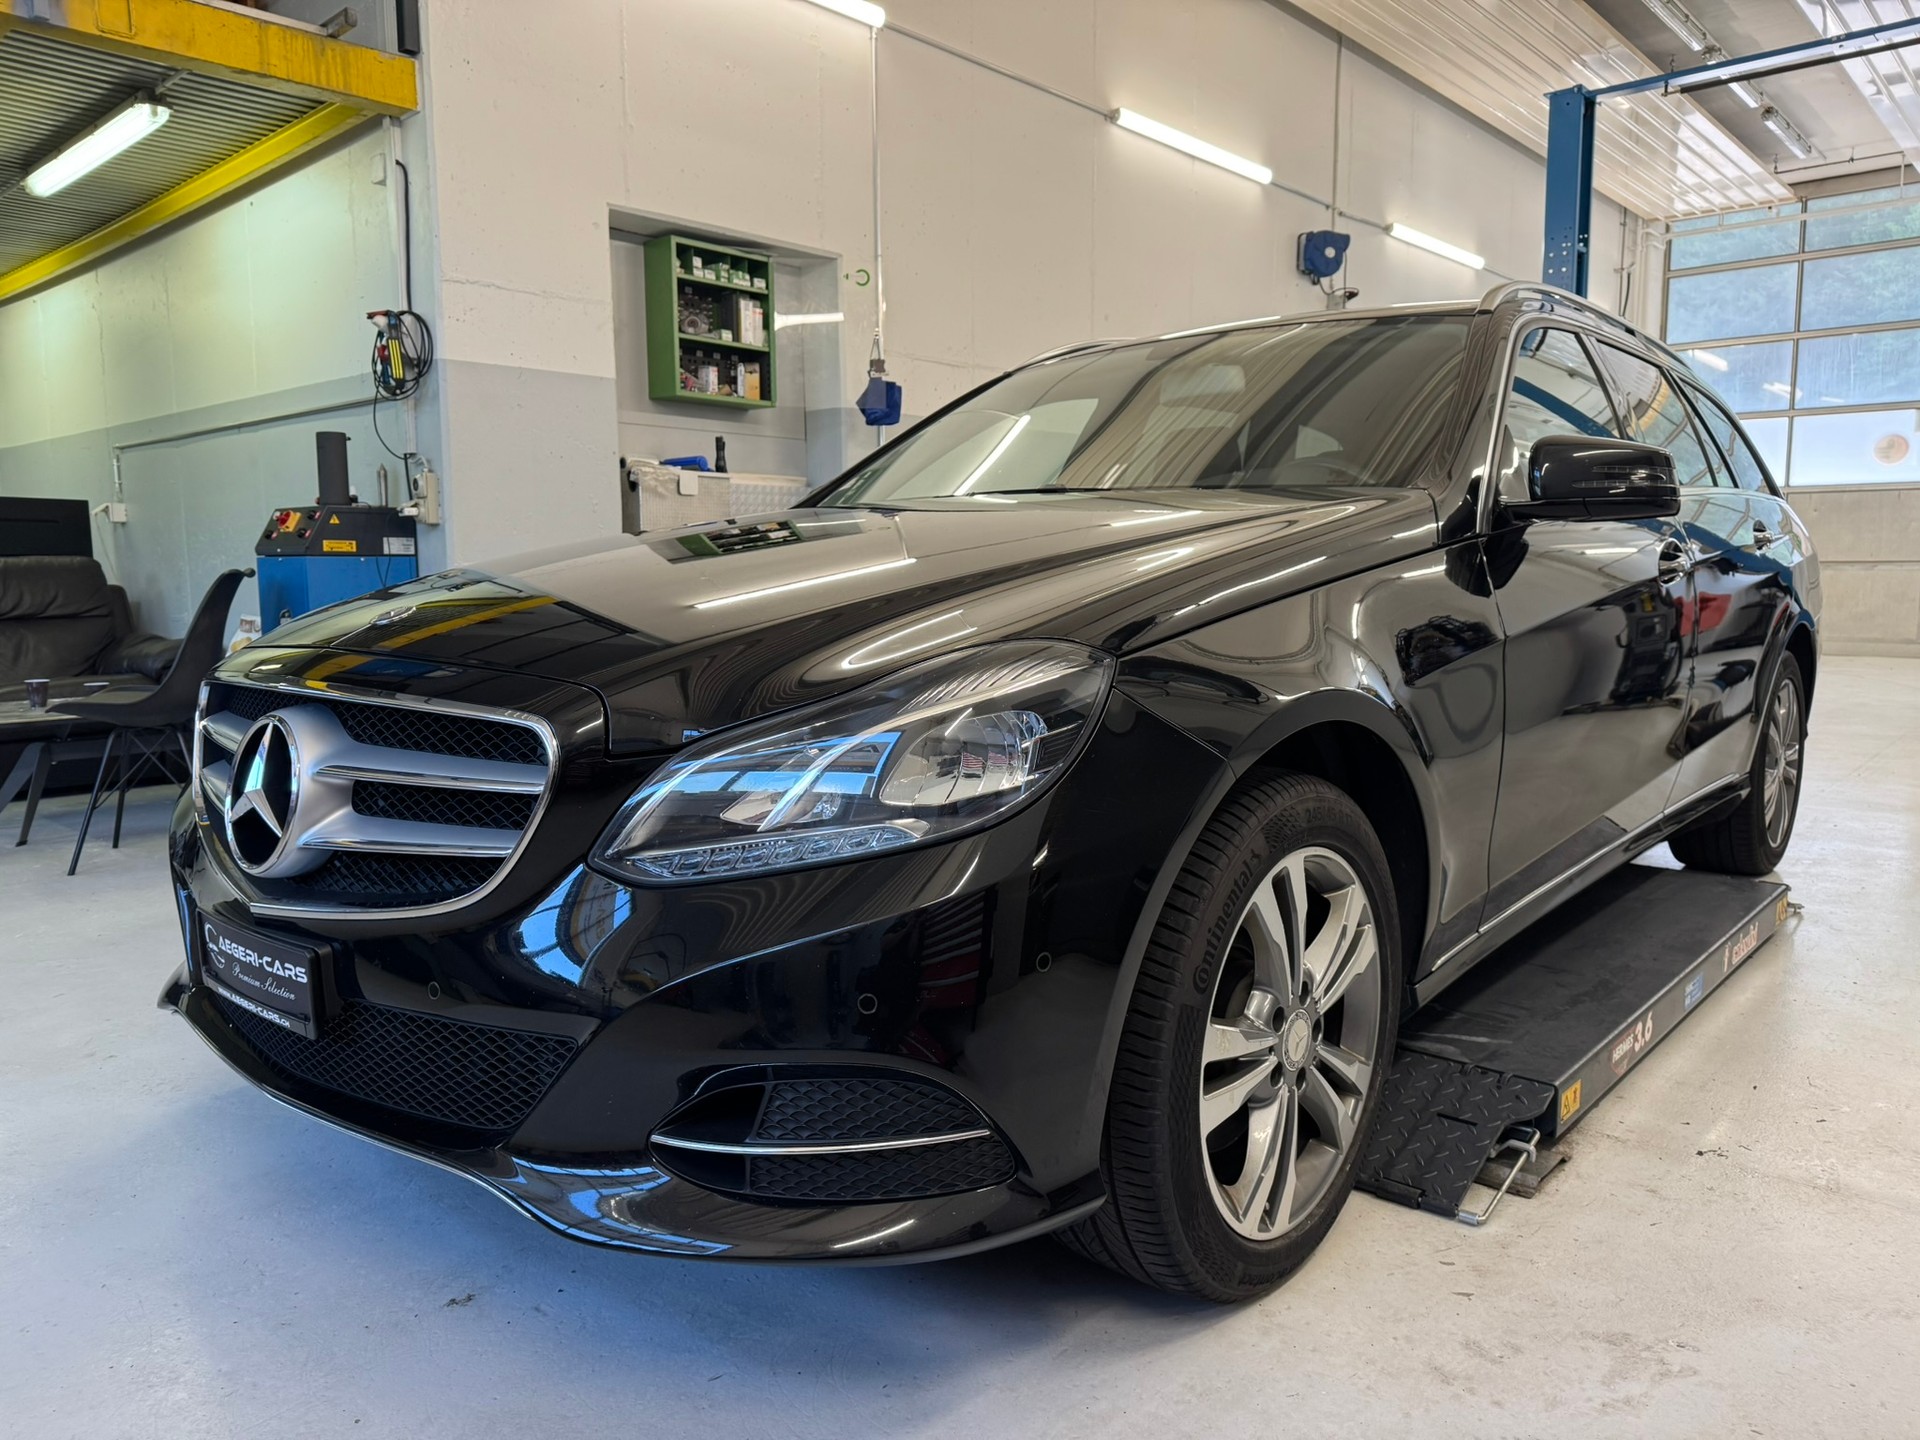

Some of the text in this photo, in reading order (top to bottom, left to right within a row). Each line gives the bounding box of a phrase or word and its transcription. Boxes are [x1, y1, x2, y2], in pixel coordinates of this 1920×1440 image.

[1192, 859, 1253, 995] Continental
[218, 935, 308, 984] AEGERI-CARS
[232, 961, 296, 1001] Premium Selection
